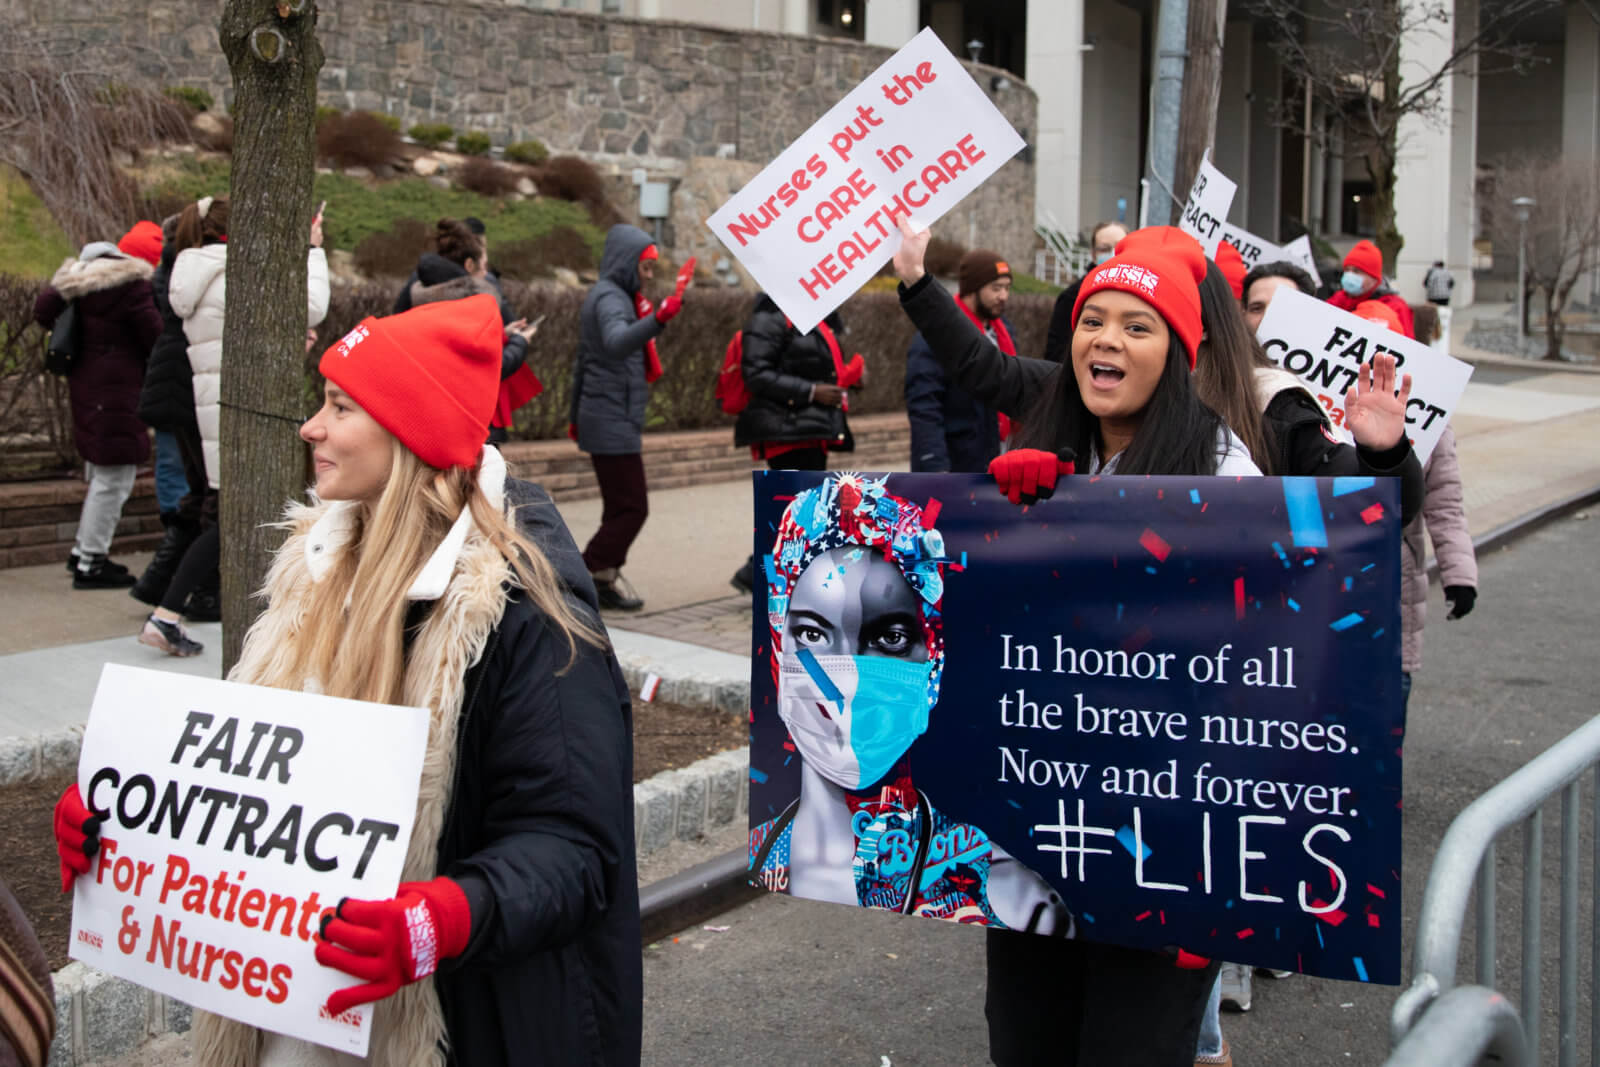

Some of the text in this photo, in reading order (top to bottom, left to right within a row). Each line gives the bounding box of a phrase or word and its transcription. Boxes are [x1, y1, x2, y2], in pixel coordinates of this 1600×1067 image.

[727, 61, 937, 247] Nurses put the
[796, 143, 914, 243] CARE in
[798, 133, 987, 301] HEALTHCARE
[1261, 338, 1447, 431] CONTCT
[1000, 634, 1297, 688] In honor of all
[170, 710, 304, 784] FAIR
[999, 689, 1359, 754] the brave nurses.
[88, 767, 400, 880] CONTRACT
[997, 746, 1358, 817] Now and forever.
[96, 837, 154, 897] For
[1034, 799, 1351, 914] #LIES
[117, 904, 293, 1005] & Nurses
